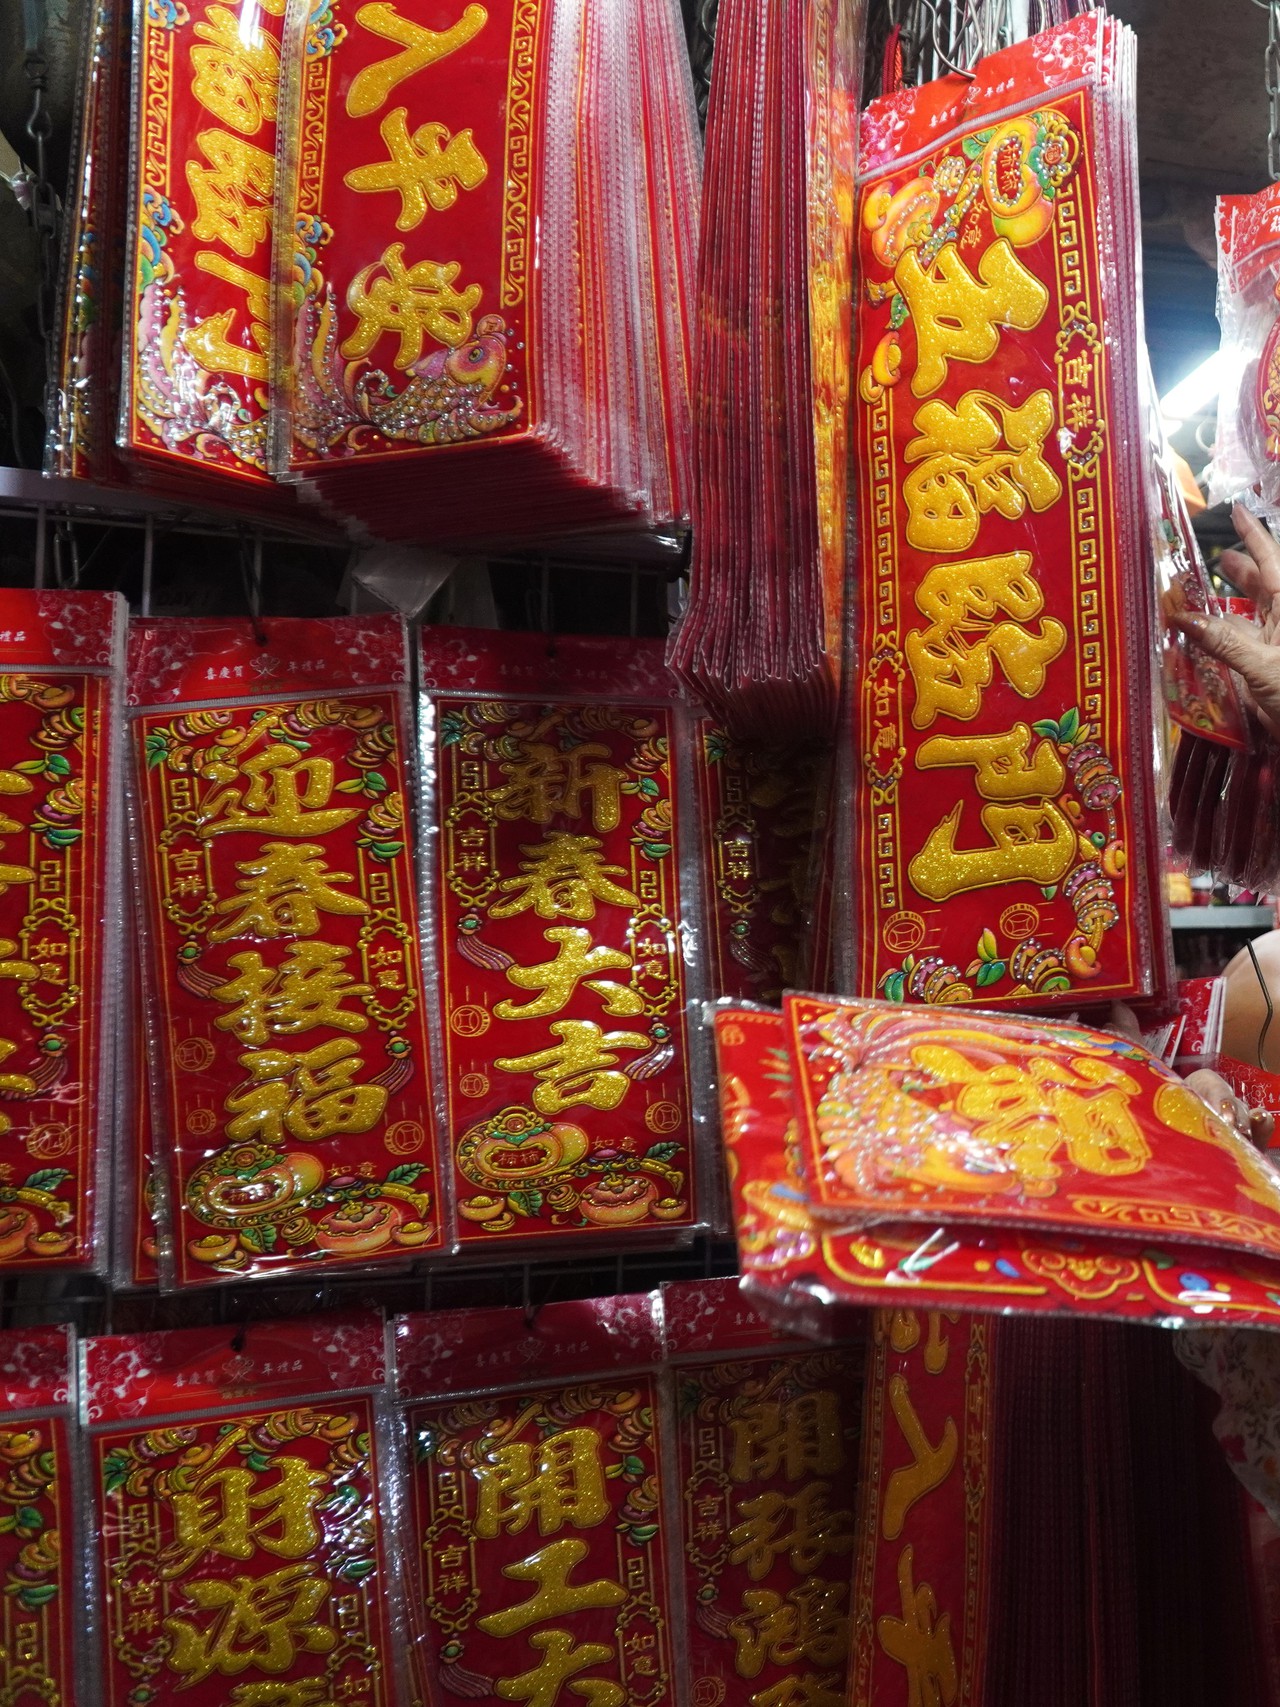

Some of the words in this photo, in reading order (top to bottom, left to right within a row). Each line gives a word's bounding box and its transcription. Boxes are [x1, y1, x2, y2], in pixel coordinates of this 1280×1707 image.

[340, 2, 488, 369] 入平安
[960, 198, 989, 250] 如意
[1063, 353, 1094, 429] 吉祥
[895, 238, 1077, 902] 五福臨門
[872, 677, 898, 756] 如意
[168, 850, 206, 899] 吉祥
[455, 829, 489, 873] 吉祥
[724, 839, 752, 881] 吉祥
[201, 740, 387, 1146] 迎春接福
[485, 740, 650, 1114] 新春大吉
[31, 938, 67, 987] 如意
[369, 944, 403, 991] 如意
[636, 938, 668, 982] 如意
[327, 1161, 376, 1178] 如意
[592, 1136, 638, 1153] 如意
[693, 1494, 725, 1542] 吉祥
[157, 1456, 338, 1707] 財源
[433, 1544, 470, 1595] 吉祥
[123, 1579, 161, 1635] 吉祥
[623, 1632, 656, 1681] 如意
